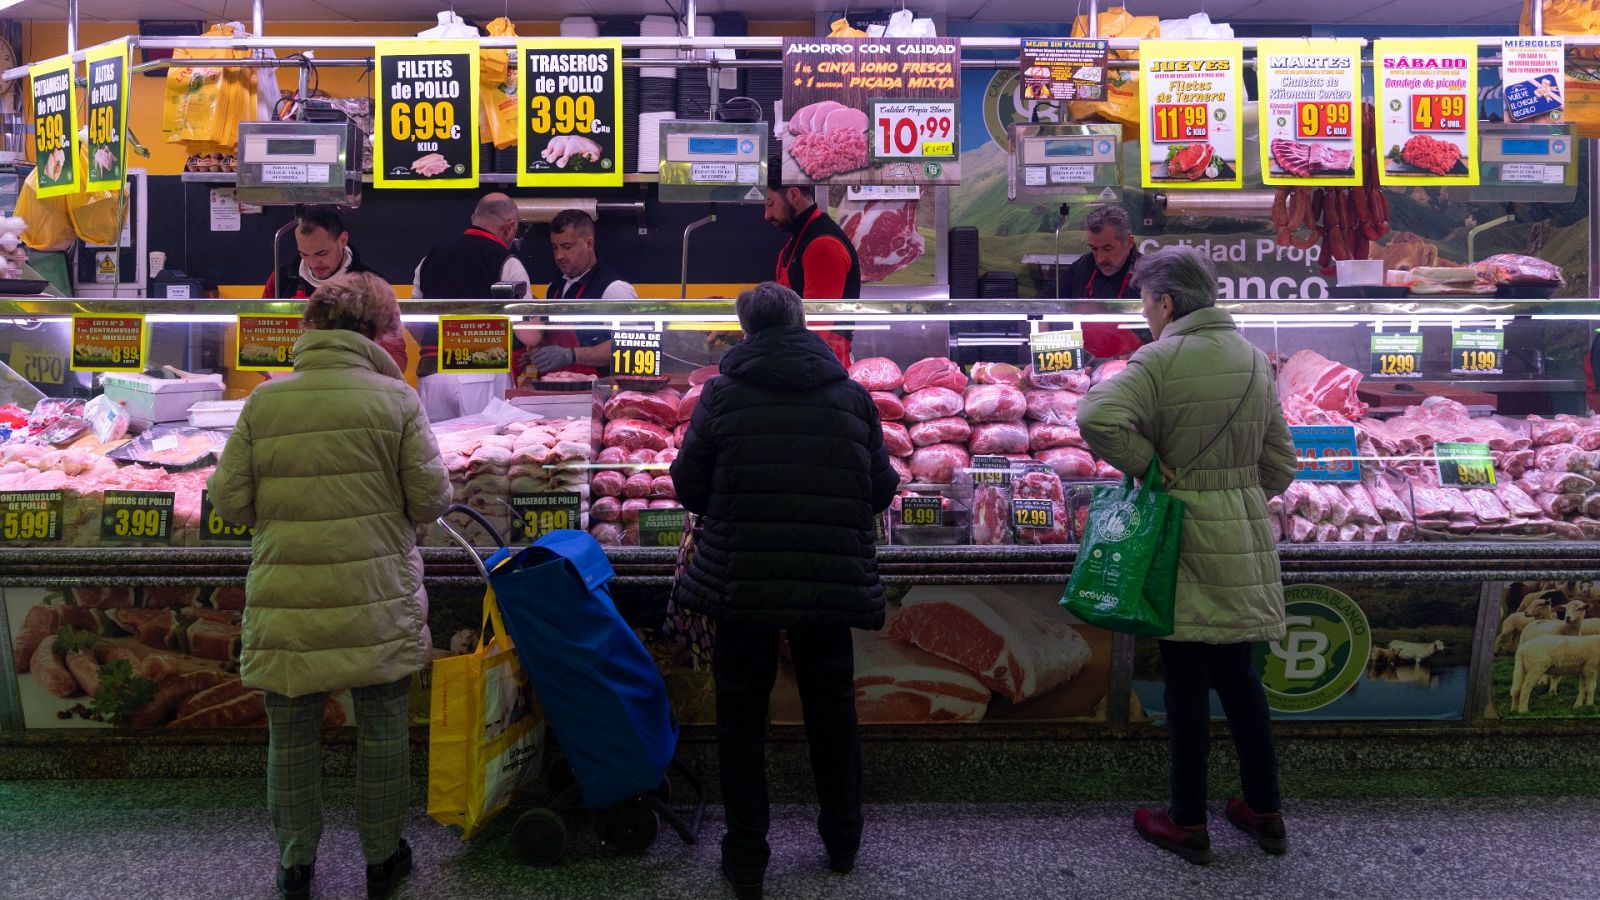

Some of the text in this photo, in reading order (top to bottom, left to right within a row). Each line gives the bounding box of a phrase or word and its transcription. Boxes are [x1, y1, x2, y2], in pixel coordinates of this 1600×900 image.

[786, 43, 956, 55] AHORRO CON CALIDAD
[1504, 39, 1562, 48] MIÉRCOLES
[530, 54, 608, 73] TRASEROS
[794, 60, 952, 75] 1 CINTA LOMO FRESCA
[1150, 60, 1230, 72] JUEVES
[1270, 57, 1351, 69] MARTES
[1383, 56, 1467, 69] SÁBADO
[95, 63, 114, 84] ALITAS
[397, 60, 453, 79] FILETES
[535, 75, 603, 93] de POLLO
[806, 76, 814, 88] 1
[849, 77, 902, 90] PICADA
[908, 77, 954, 90] MIXTA
[1169, 81, 1212, 91] Filetes
[1281, 77, 1339, 87] Chuletas de
[1385, 78, 1421, 89] Bandeja
[1423, 78, 1434, 88] de
[1436, 77, 1467, 89] picada
[92, 83, 117, 104] de POLLO
[391, 80, 460, 99] de POLLO
[1507, 89, 1529, 102] VUELVE
[1156, 92, 1226, 103] de Ternera
[1517, 97, 1539, 109] CHEQUE
[37, 94, 66, 115] de POLLO
[879, 106, 906, 114] Calidad
[907, 106, 928, 116] Propia
[1512, 107, 1536, 118] REGALO
[417, 142, 438, 152] KILO
[1139, 239, 1321, 266] Cdad Prop
[1217, 275, 1329, 299] anco
[613, 332, 646, 340] AGUJA
[0, 493, 62, 503] ONTRAMUSLOS
[105, 497, 137, 505] MUSLOS
[138, 497, 148, 505] DE
[513, 497, 547, 505] TRASEROS
[558, 496, 578, 504] POLLO
[9, 501, 47, 510] DE POLLO
[1107, 529, 1131, 540] VIDRIO
[1079, 589, 1119, 604] ecovidrio
[1284, 588, 1366, 636] PROPIA BLANCO
